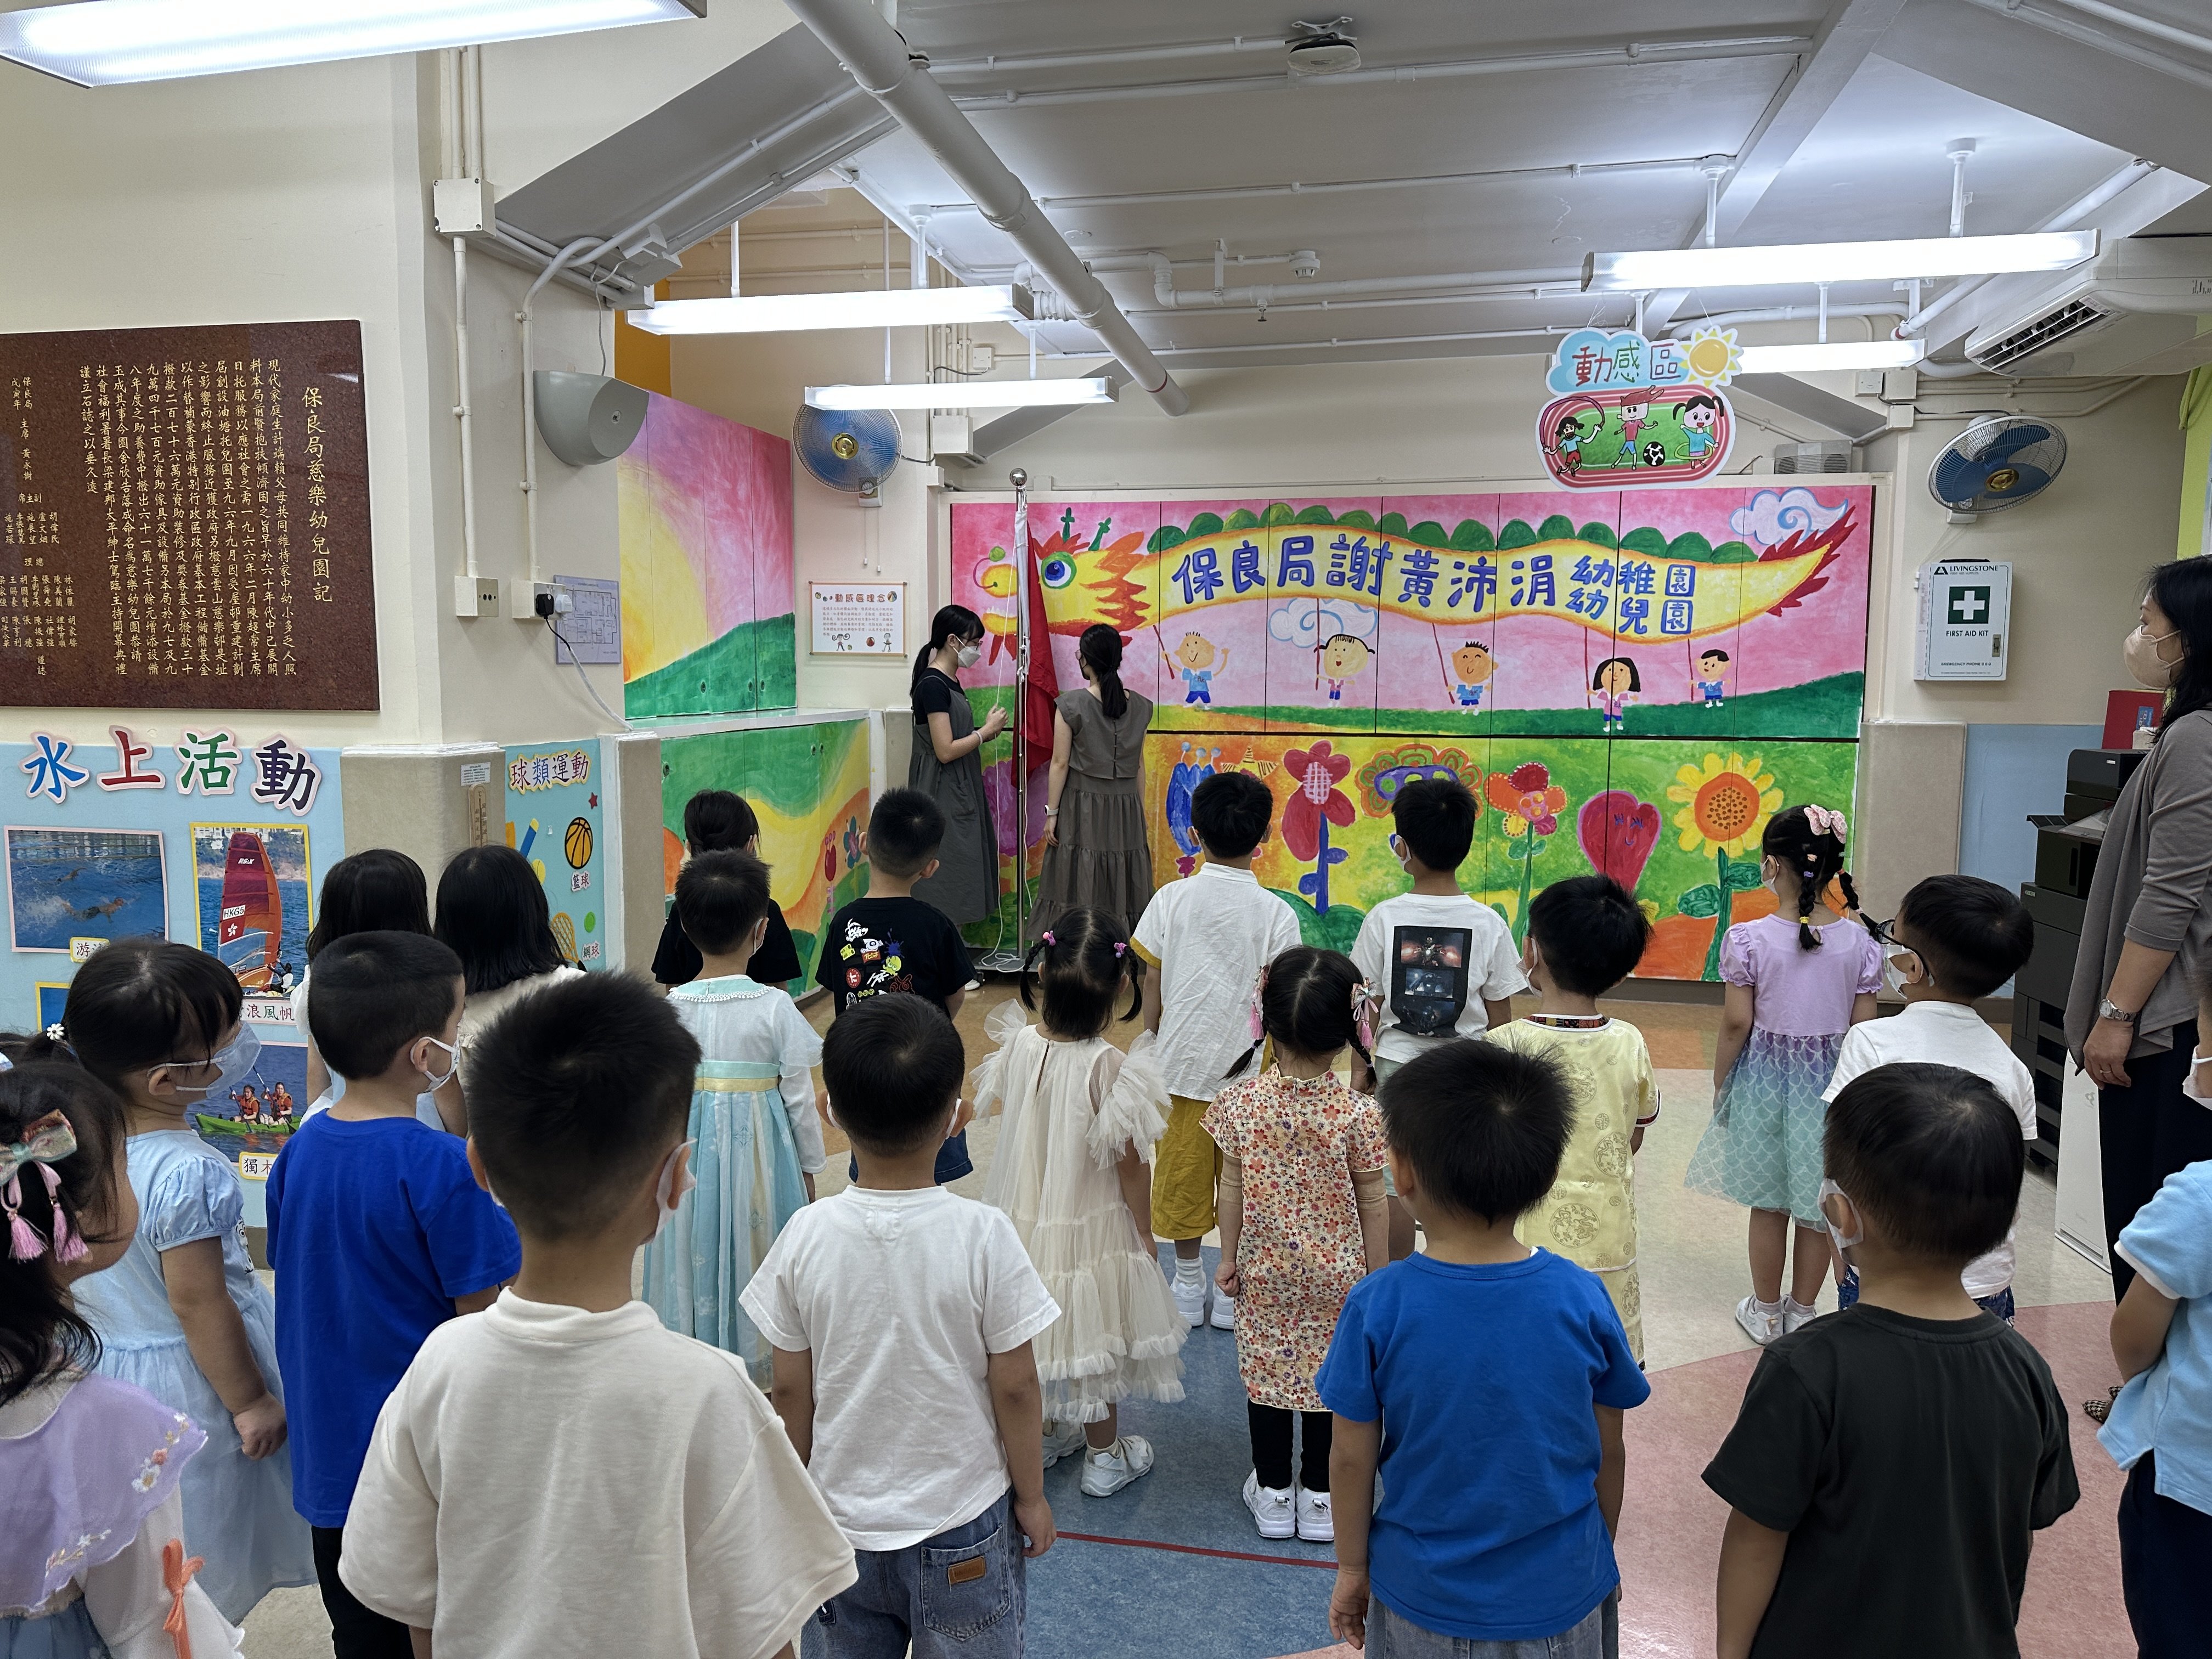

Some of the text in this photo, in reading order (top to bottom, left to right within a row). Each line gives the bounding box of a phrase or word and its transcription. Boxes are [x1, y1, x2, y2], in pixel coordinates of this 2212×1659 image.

[1572, 340, 1681, 387] 動感區
[301, 386, 332, 602] 保良局慈樂幼兒園記
[1171, 534, 1556, 613] 保良局謝黃沛涓
[1570, 555, 1696, 597] 幼稚園
[1565, 588, 1694, 635] 幼兒園
[25, 730, 316, 810] 水上活動
[511, 752, 589, 790] 球類運動
[573, 872, 590, 890] 籃球
[223, 906, 245, 919] HKG5
[583, 943, 600, 958] 網球
[240, 1003, 295, 1021] 浪風帆
